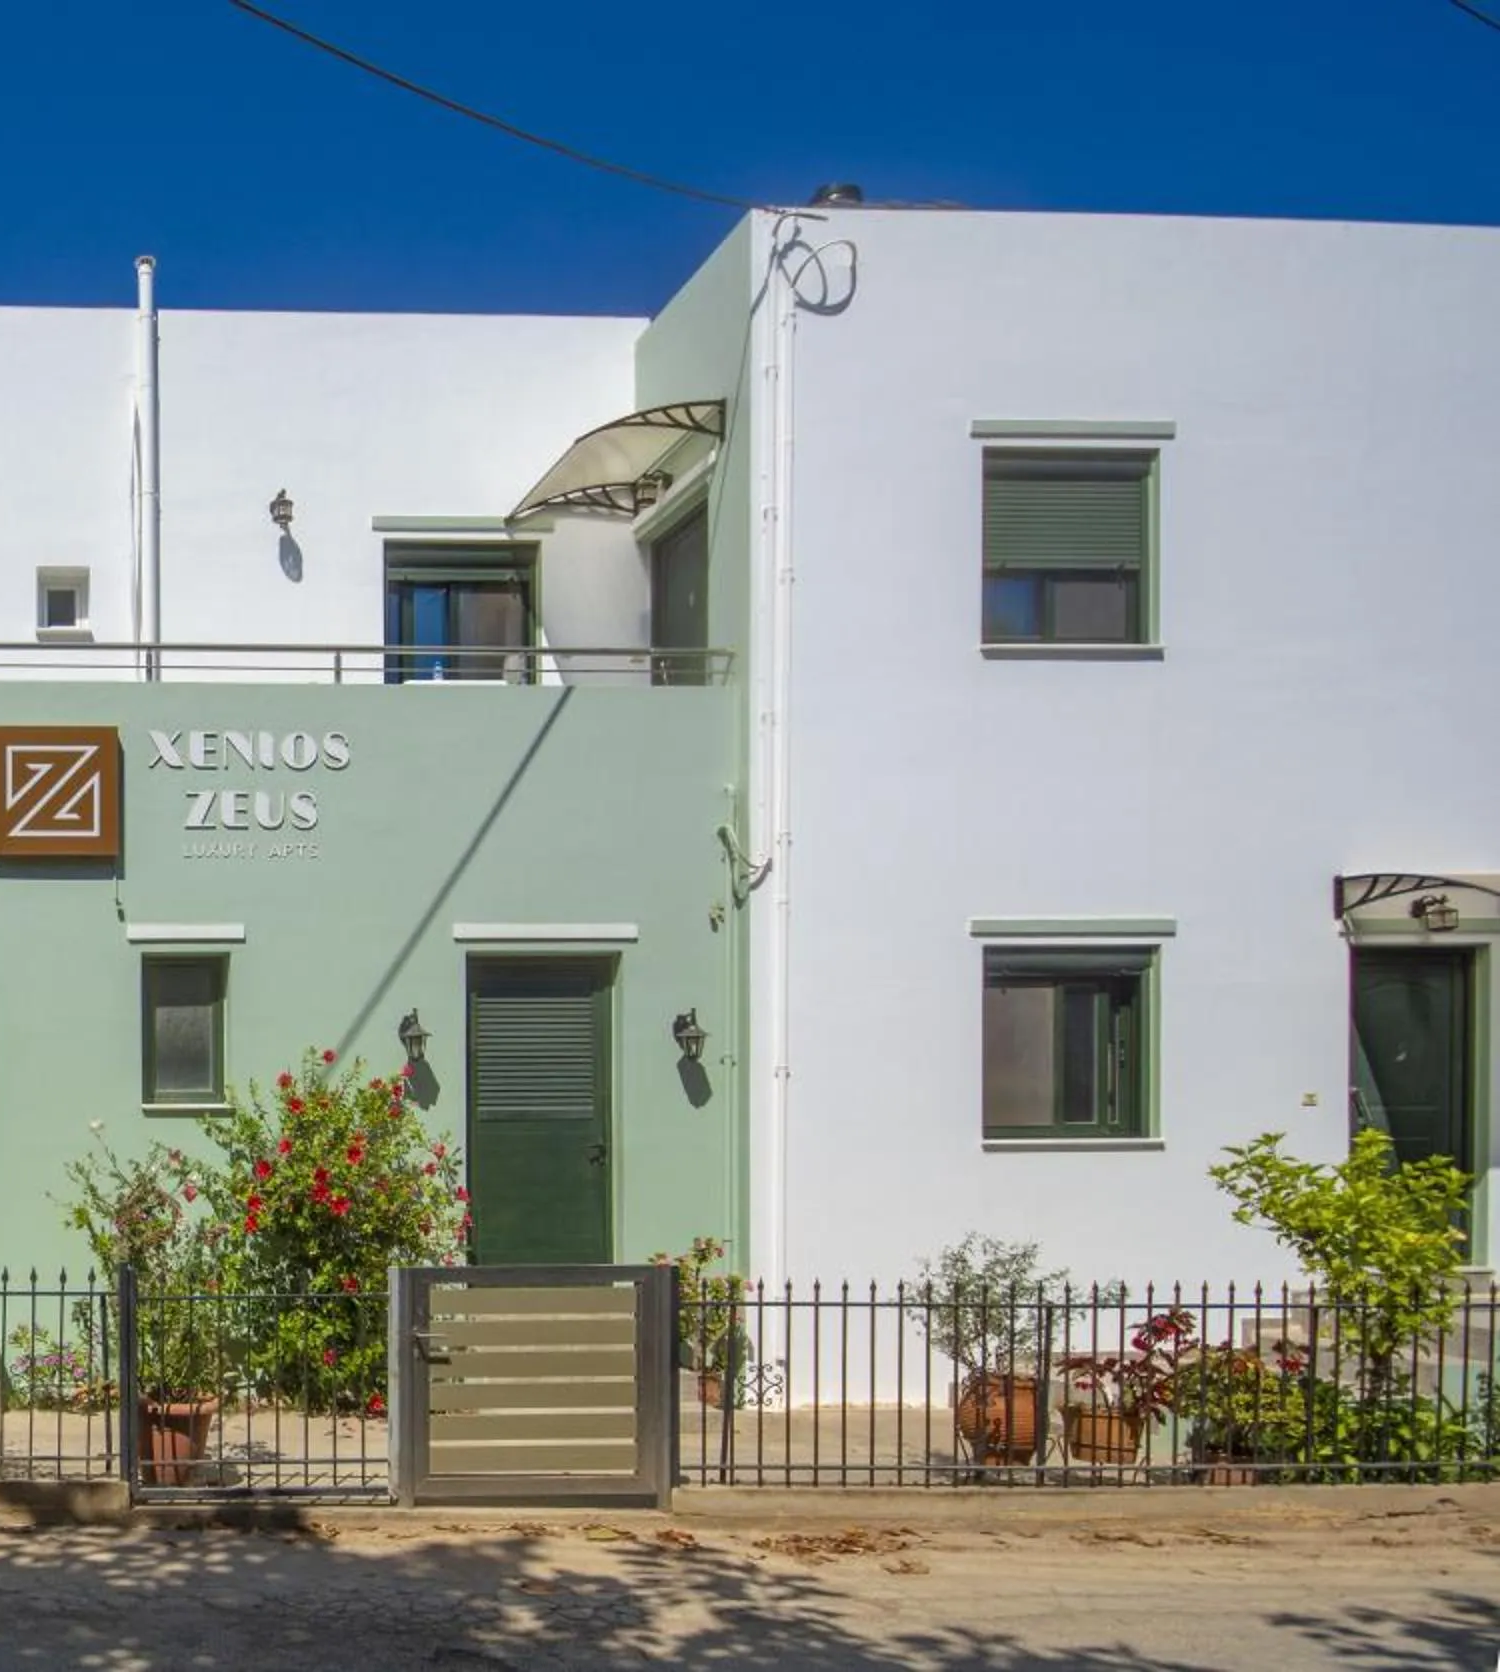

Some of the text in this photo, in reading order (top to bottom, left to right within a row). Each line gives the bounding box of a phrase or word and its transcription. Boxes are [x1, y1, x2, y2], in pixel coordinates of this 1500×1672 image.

[148, 730, 350, 771] XENIOS
[184, 789, 318, 830] ZEUS
[182, 842, 320, 860] LUXURY APTS
